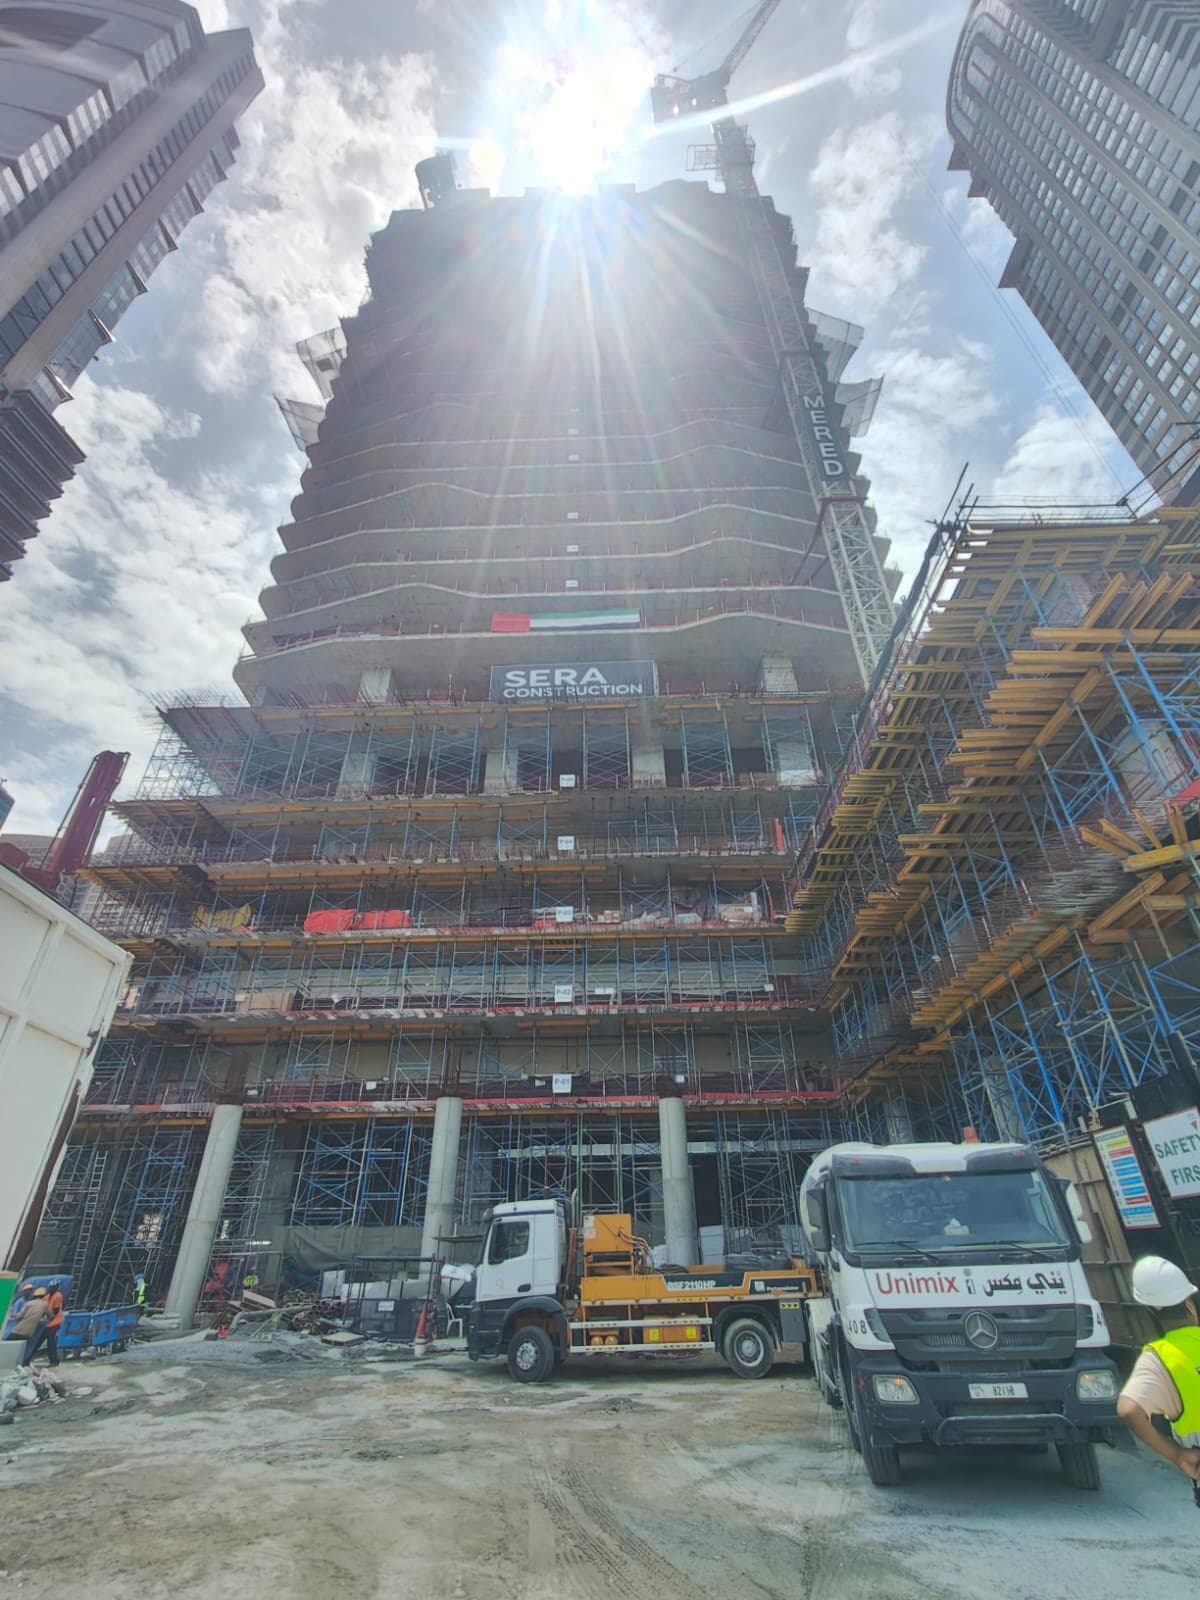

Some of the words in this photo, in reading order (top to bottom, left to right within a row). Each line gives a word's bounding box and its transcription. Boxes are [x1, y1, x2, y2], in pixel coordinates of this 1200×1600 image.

[803, 395, 844, 476] MERED
[504, 667, 607, 688] SERA
[503, 683, 643, 699] CONSTRUCTION
[875, 1271, 960, 1295] Unimix
